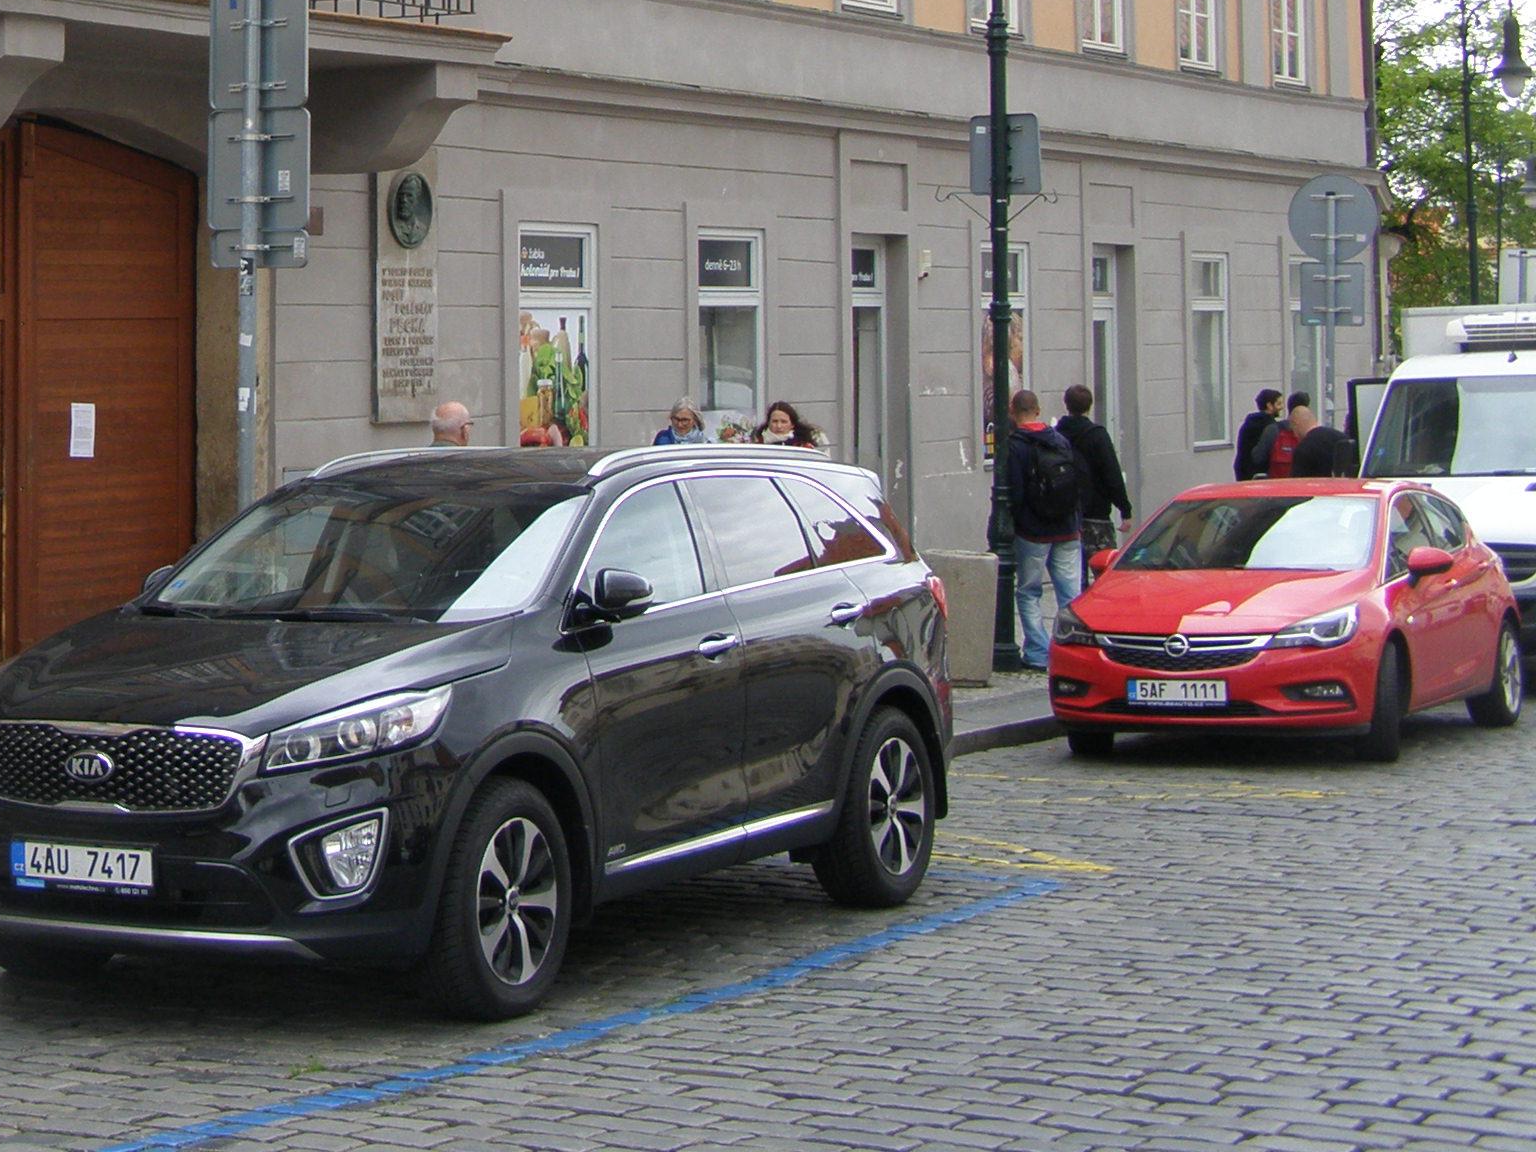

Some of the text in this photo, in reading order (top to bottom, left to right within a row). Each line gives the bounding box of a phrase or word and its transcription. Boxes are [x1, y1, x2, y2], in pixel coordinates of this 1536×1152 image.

[1139, 682, 1218, 699] 5AF 1111
[72, 758, 104, 776] KIA
[30, 846, 141, 881] 4AU 7417
